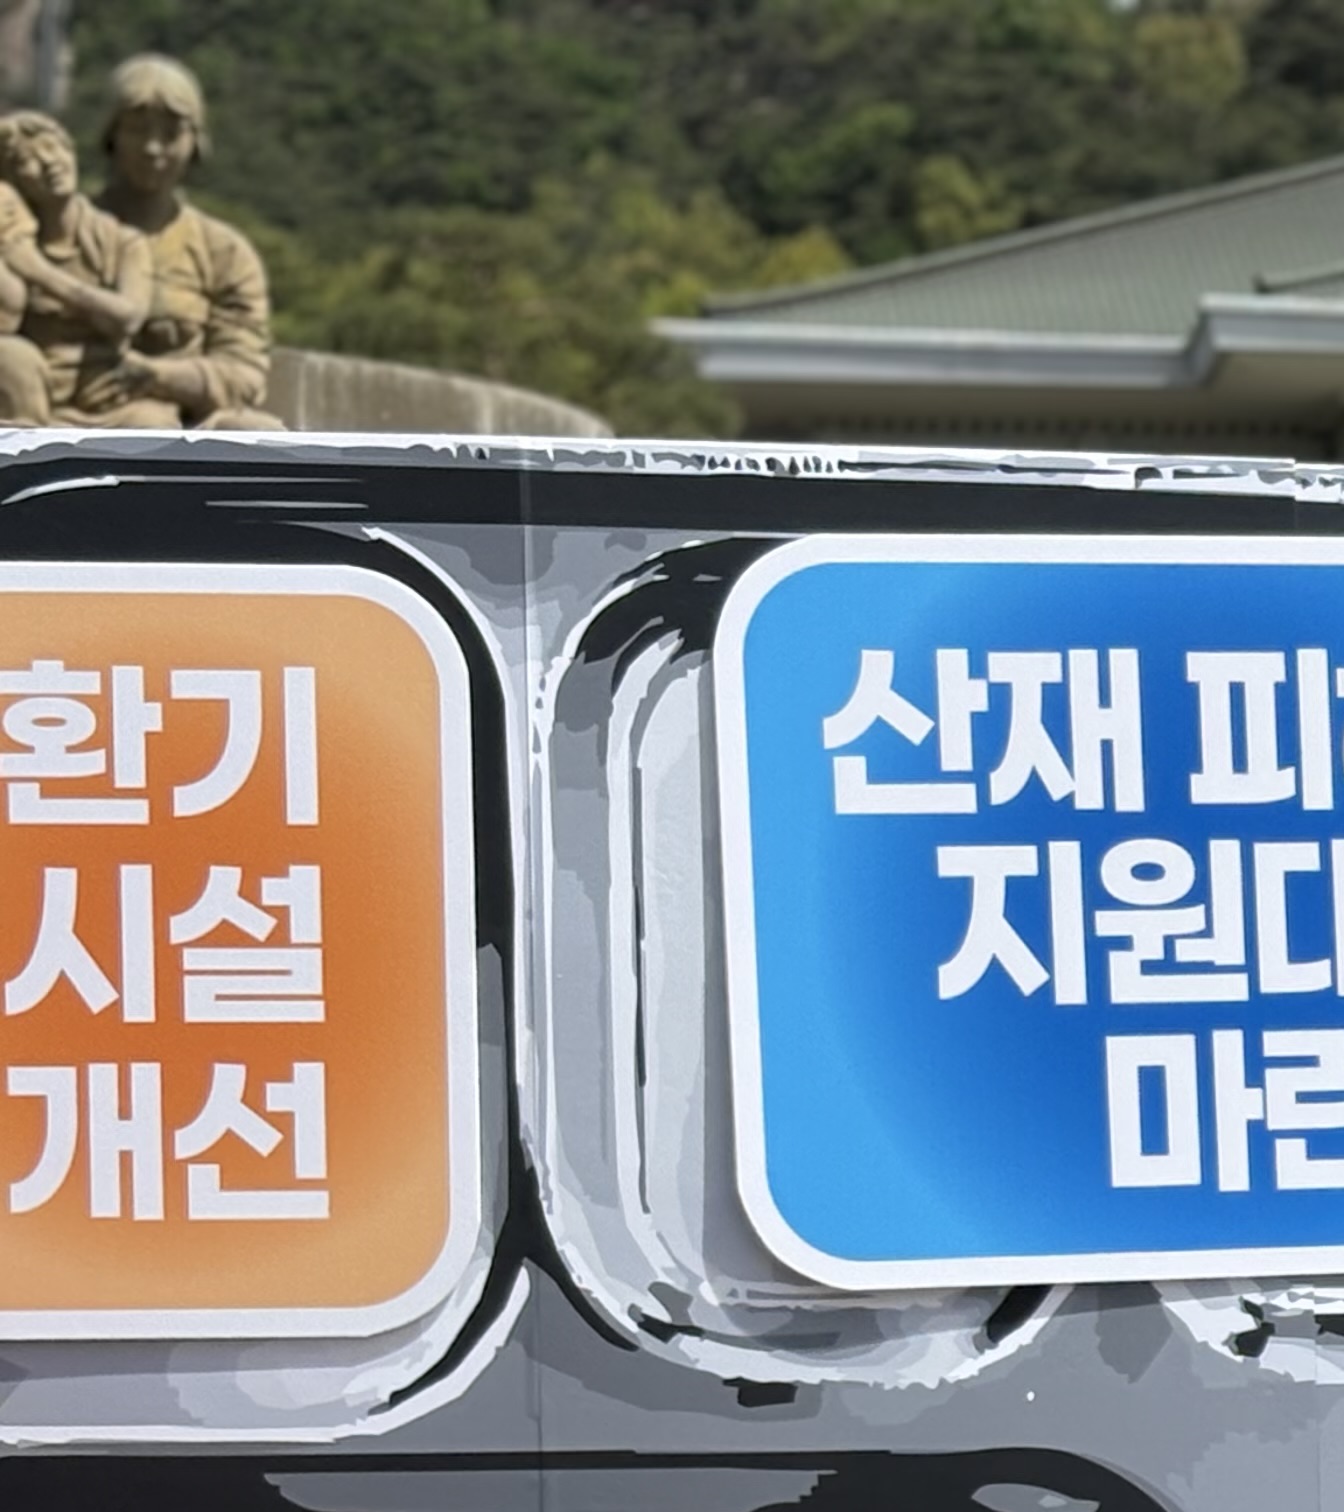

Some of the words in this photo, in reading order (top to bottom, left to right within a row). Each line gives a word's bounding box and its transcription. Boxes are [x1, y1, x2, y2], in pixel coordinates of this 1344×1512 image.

[0, 660, 319, 826] 환기
[823, 648, 1145, 814] 산재
[5, 864, 326, 1023] 시설
[7, 1061, 330, 1221] 개선
